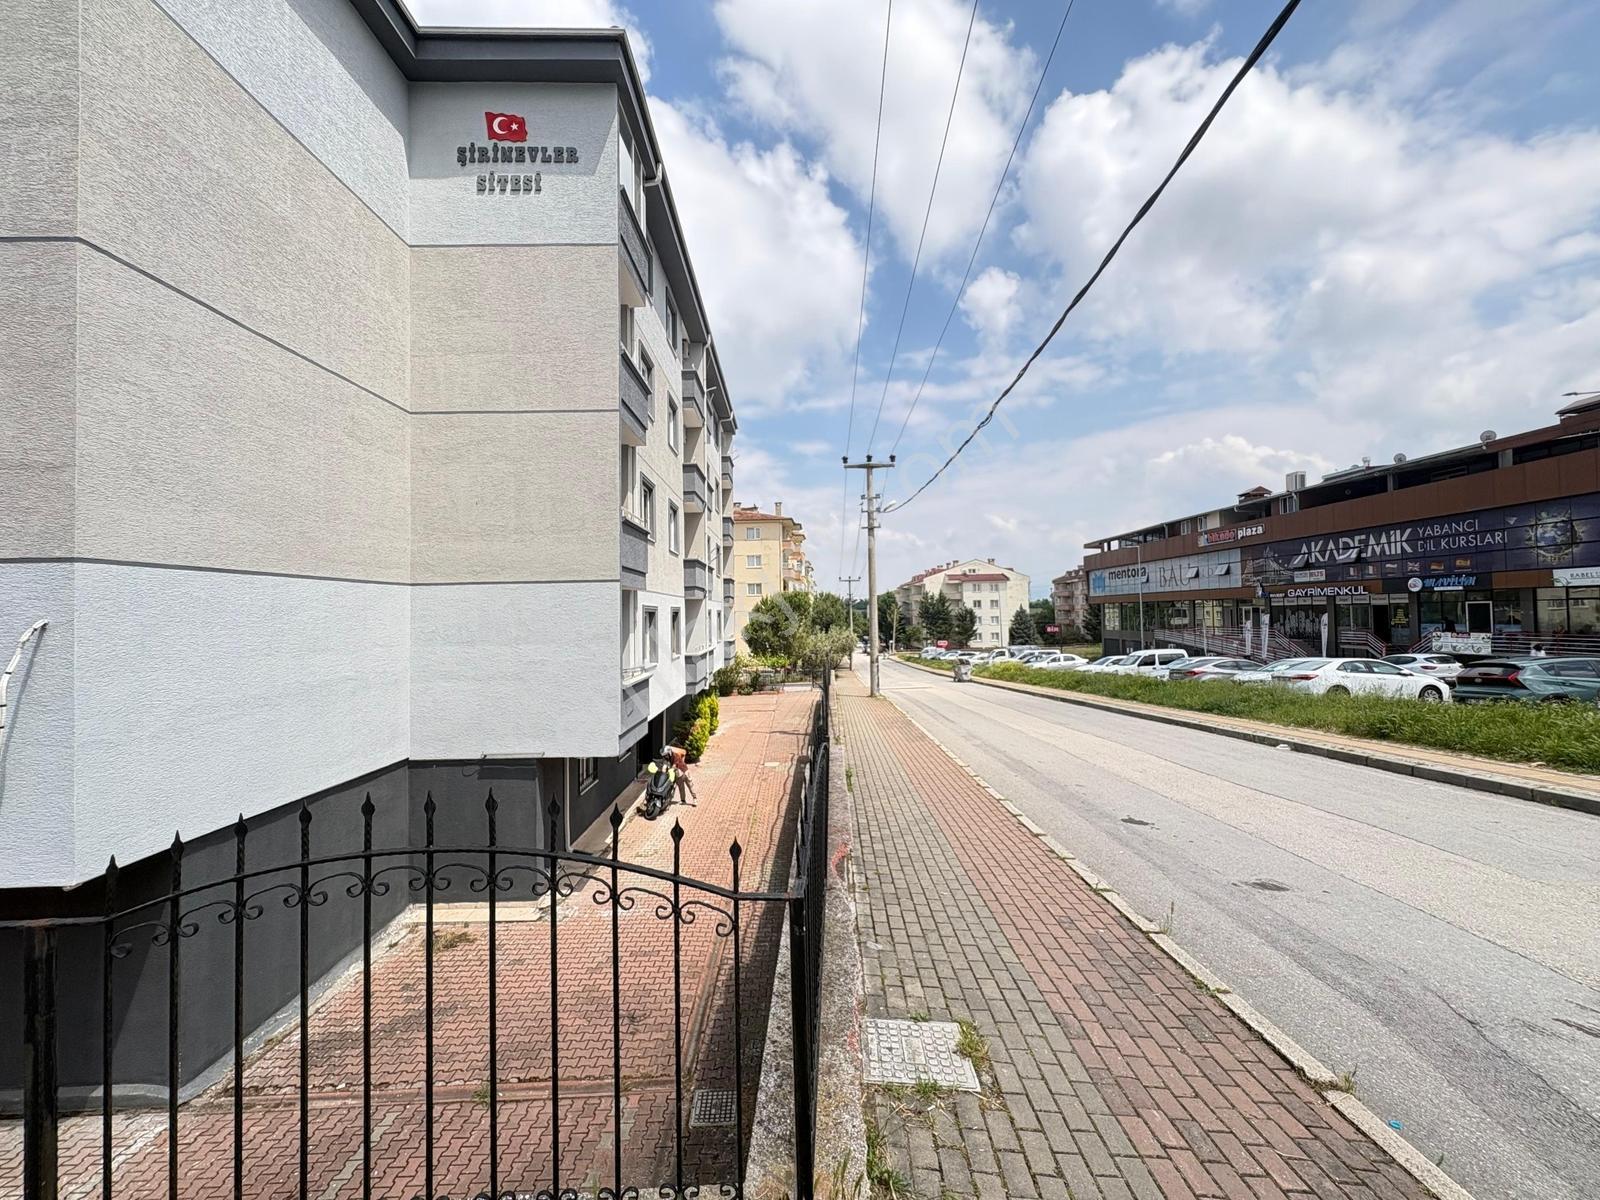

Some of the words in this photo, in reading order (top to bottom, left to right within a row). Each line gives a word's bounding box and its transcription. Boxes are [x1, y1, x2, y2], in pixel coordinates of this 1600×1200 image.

[457, 142, 579, 166] ŞİRİNEVLER
[476, 171, 541, 194] SİTESİ
[1237, 525, 1263, 539] plaza
[1417, 519, 1479, 537] YABANCI
[1295, 528, 1414, 562] AKADEMİK
[1441, 531, 1508, 549] KURSLARI
[1108, 566, 1147, 580] mentora
[1159, 563, 1191, 588] BAU
[1287, 585, 1369, 597] GAYRİMENKUL
